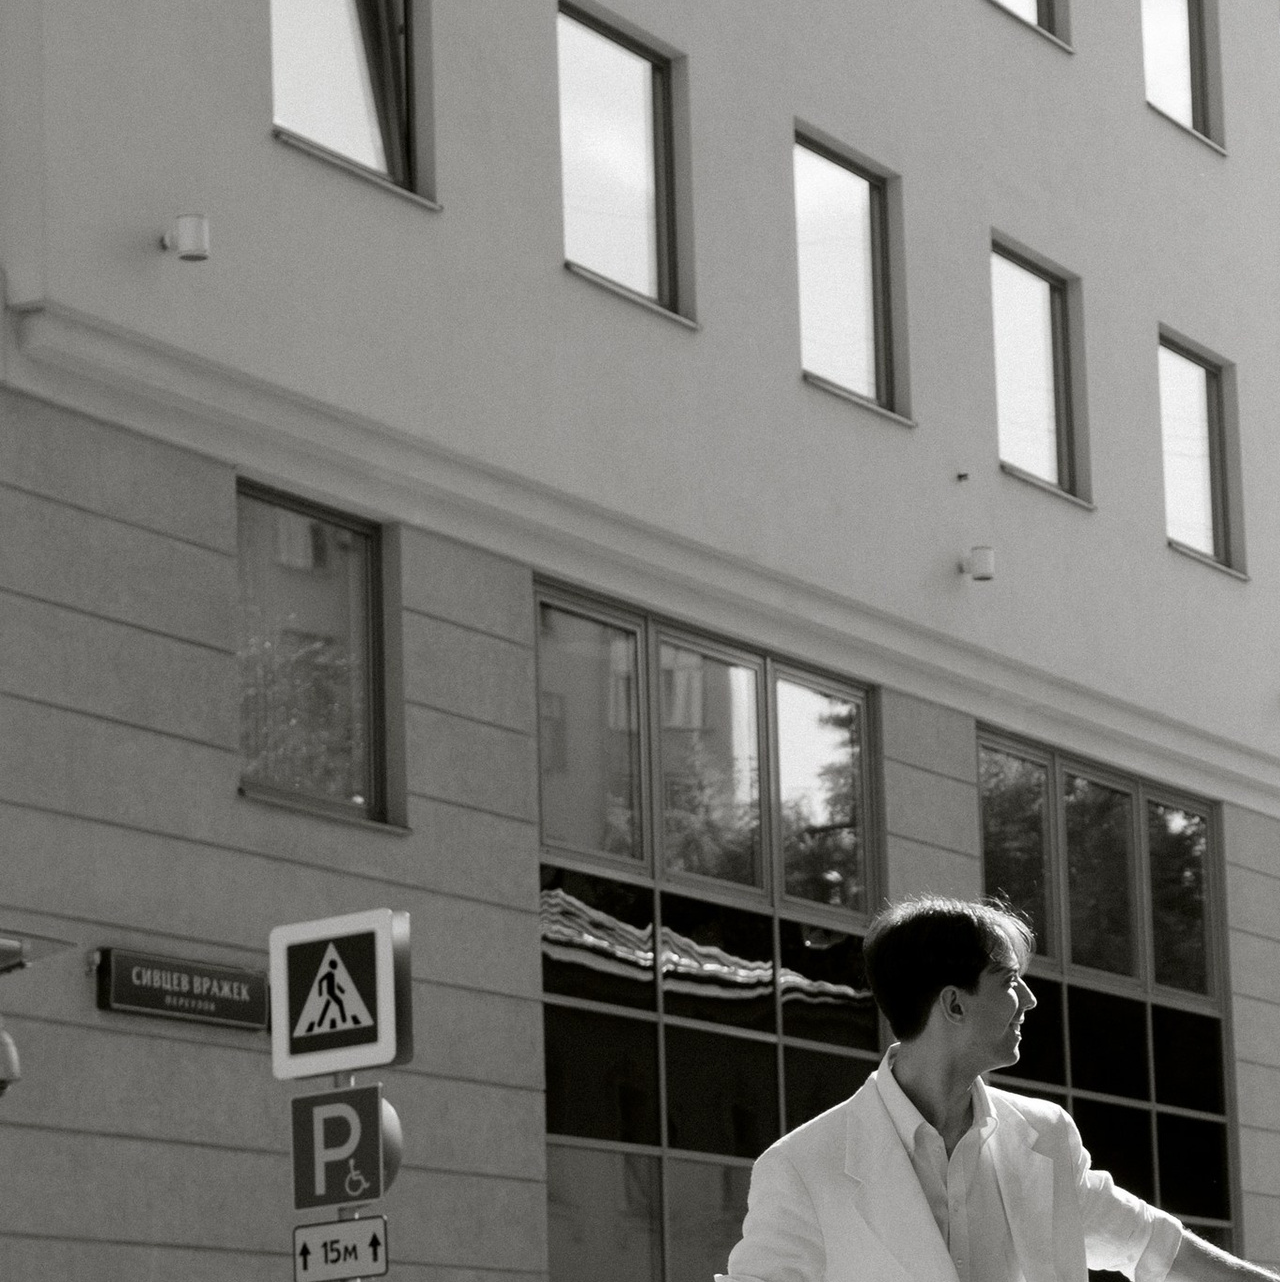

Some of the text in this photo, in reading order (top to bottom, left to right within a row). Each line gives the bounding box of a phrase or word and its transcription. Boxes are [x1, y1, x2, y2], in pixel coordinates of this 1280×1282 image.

[131, 966, 250, 1002] СИВЦЕВ ВРАЖЕК
[312, 1102, 362, 1197] P
